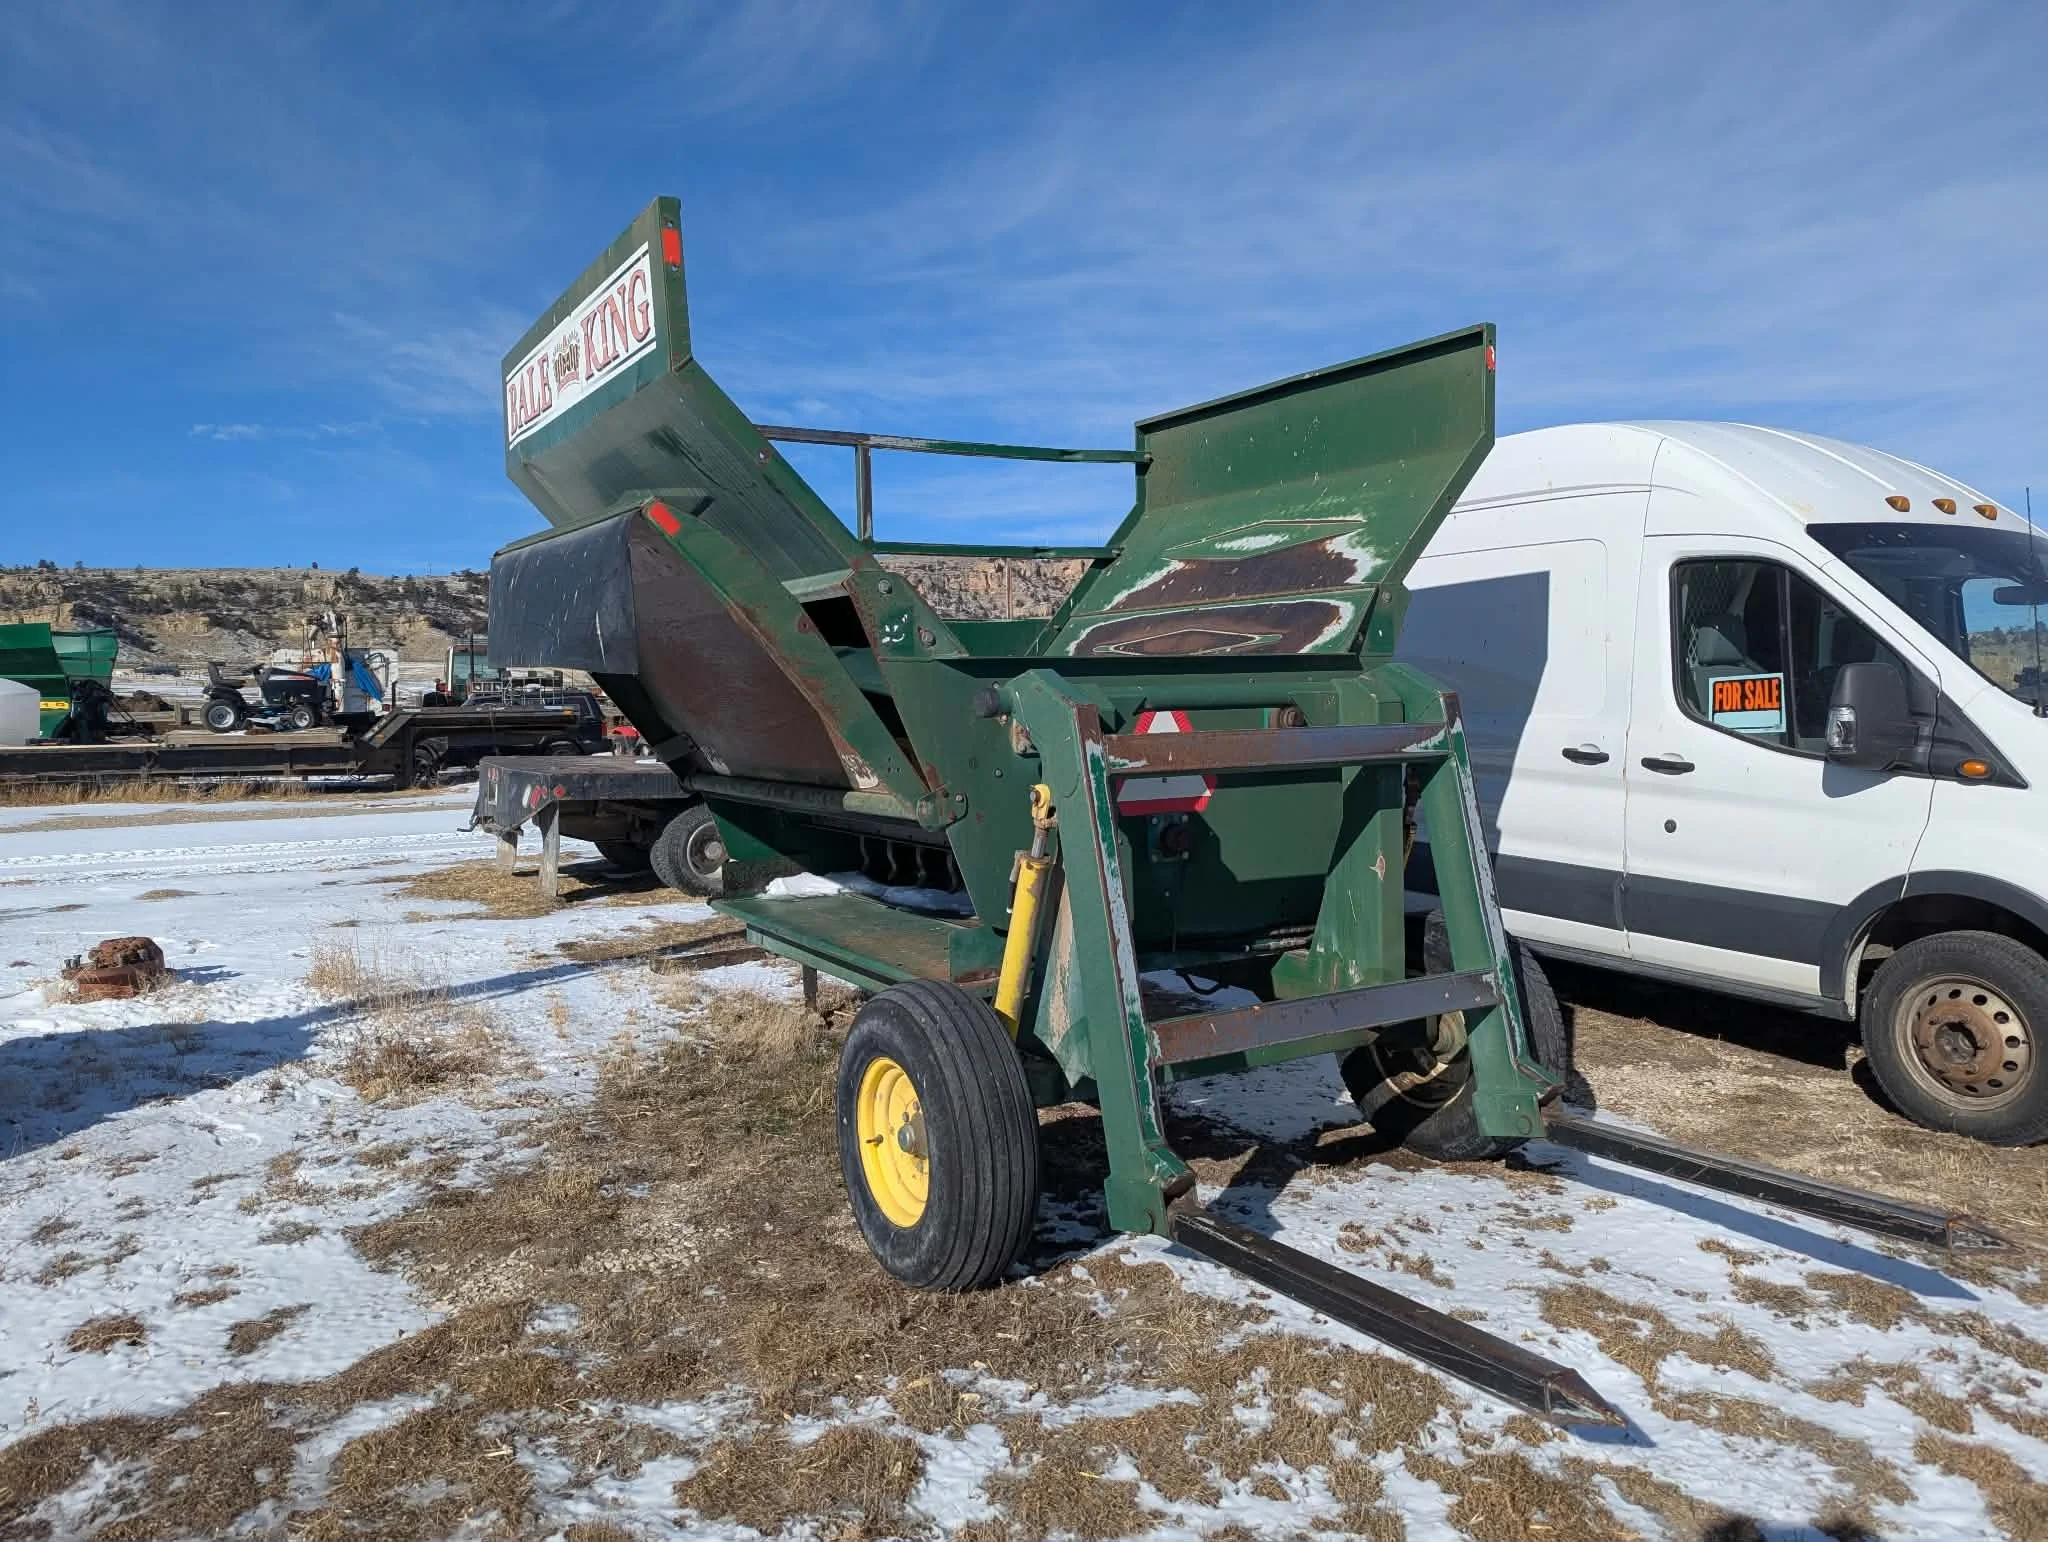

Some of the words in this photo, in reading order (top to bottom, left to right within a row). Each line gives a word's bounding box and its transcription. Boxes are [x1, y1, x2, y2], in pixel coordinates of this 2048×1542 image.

[509, 353, 552, 436] BALE
[580, 269, 650, 380] KING
[1714, 682, 1741, 712] FOR
[1744, 679, 1780, 710] SALE
